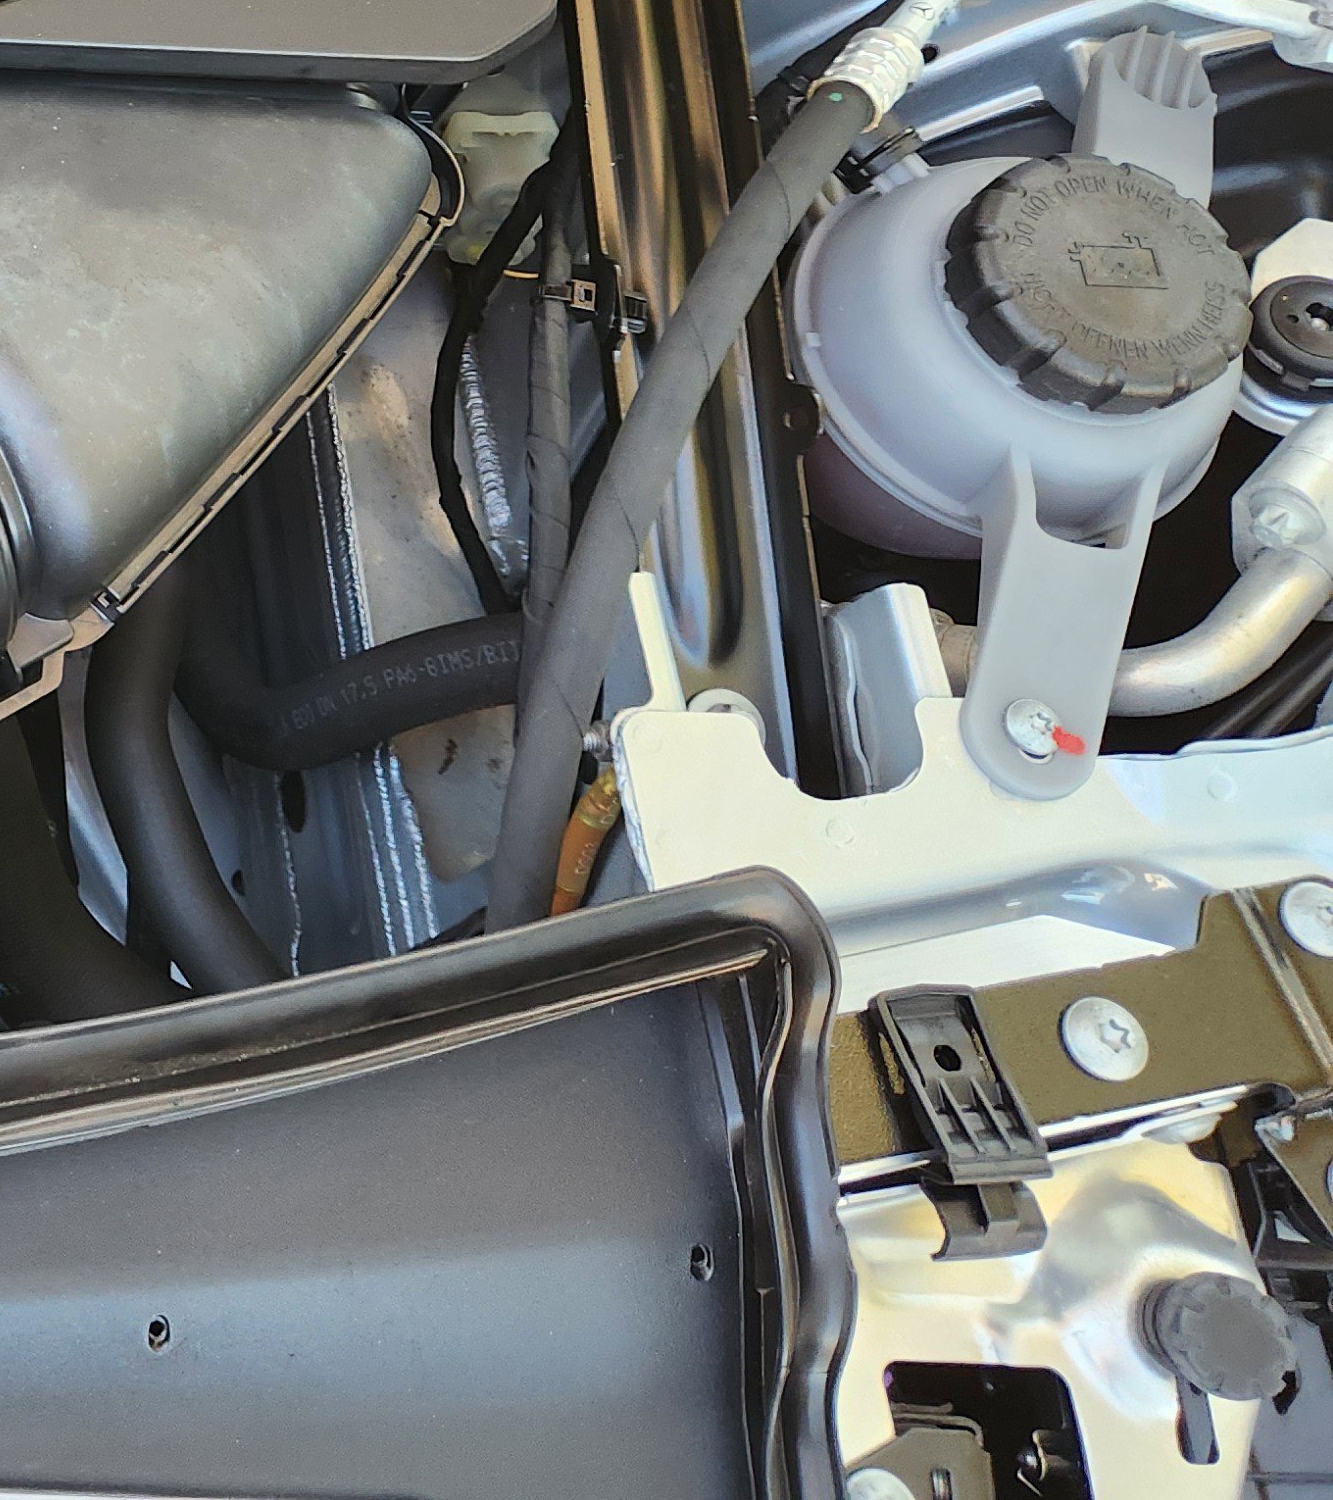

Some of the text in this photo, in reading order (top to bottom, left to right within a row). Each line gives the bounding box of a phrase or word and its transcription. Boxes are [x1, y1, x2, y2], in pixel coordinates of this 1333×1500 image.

[1053, 175, 1107, 198] OPEN
[1116, 179, 1179, 219] WHEN
[1020, 187, 1056, 221] NOT
[1013, 220, 1035, 247] DO
